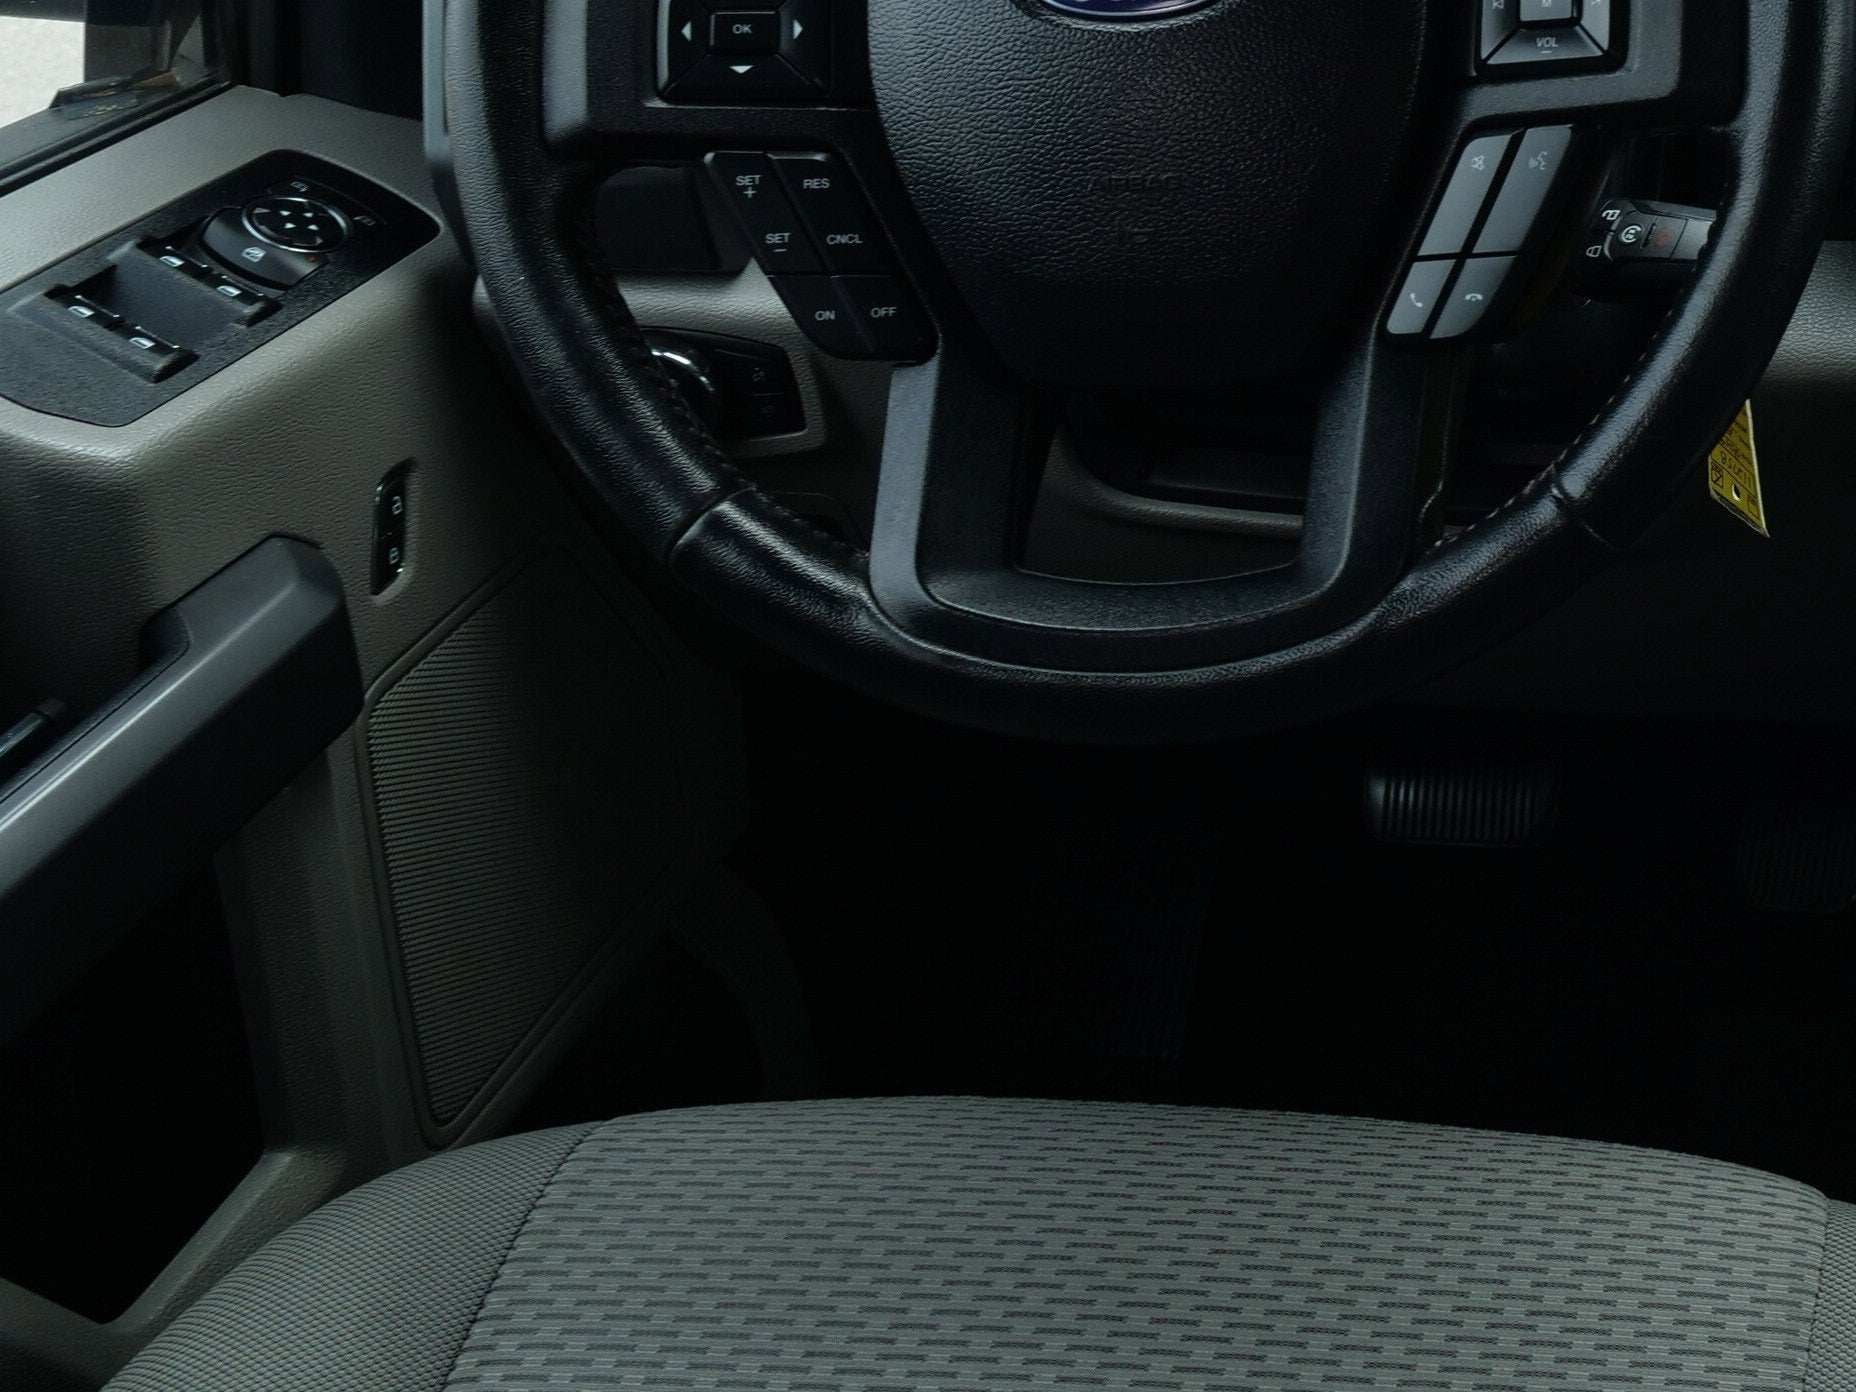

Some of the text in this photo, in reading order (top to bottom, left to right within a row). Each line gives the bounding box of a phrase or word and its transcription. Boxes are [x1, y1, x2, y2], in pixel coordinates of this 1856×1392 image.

[732, 22, 753, 35] OK
[1535, 36, 1559, 48] VOL
[735, 174, 763, 187] SET
[802, 177, 831, 190] RES
[765, 232, 793, 245] SET
[826, 233, 864, 245] CNCL
[814, 309, 837, 322] ON
[869, 306, 899, 319] OFF
